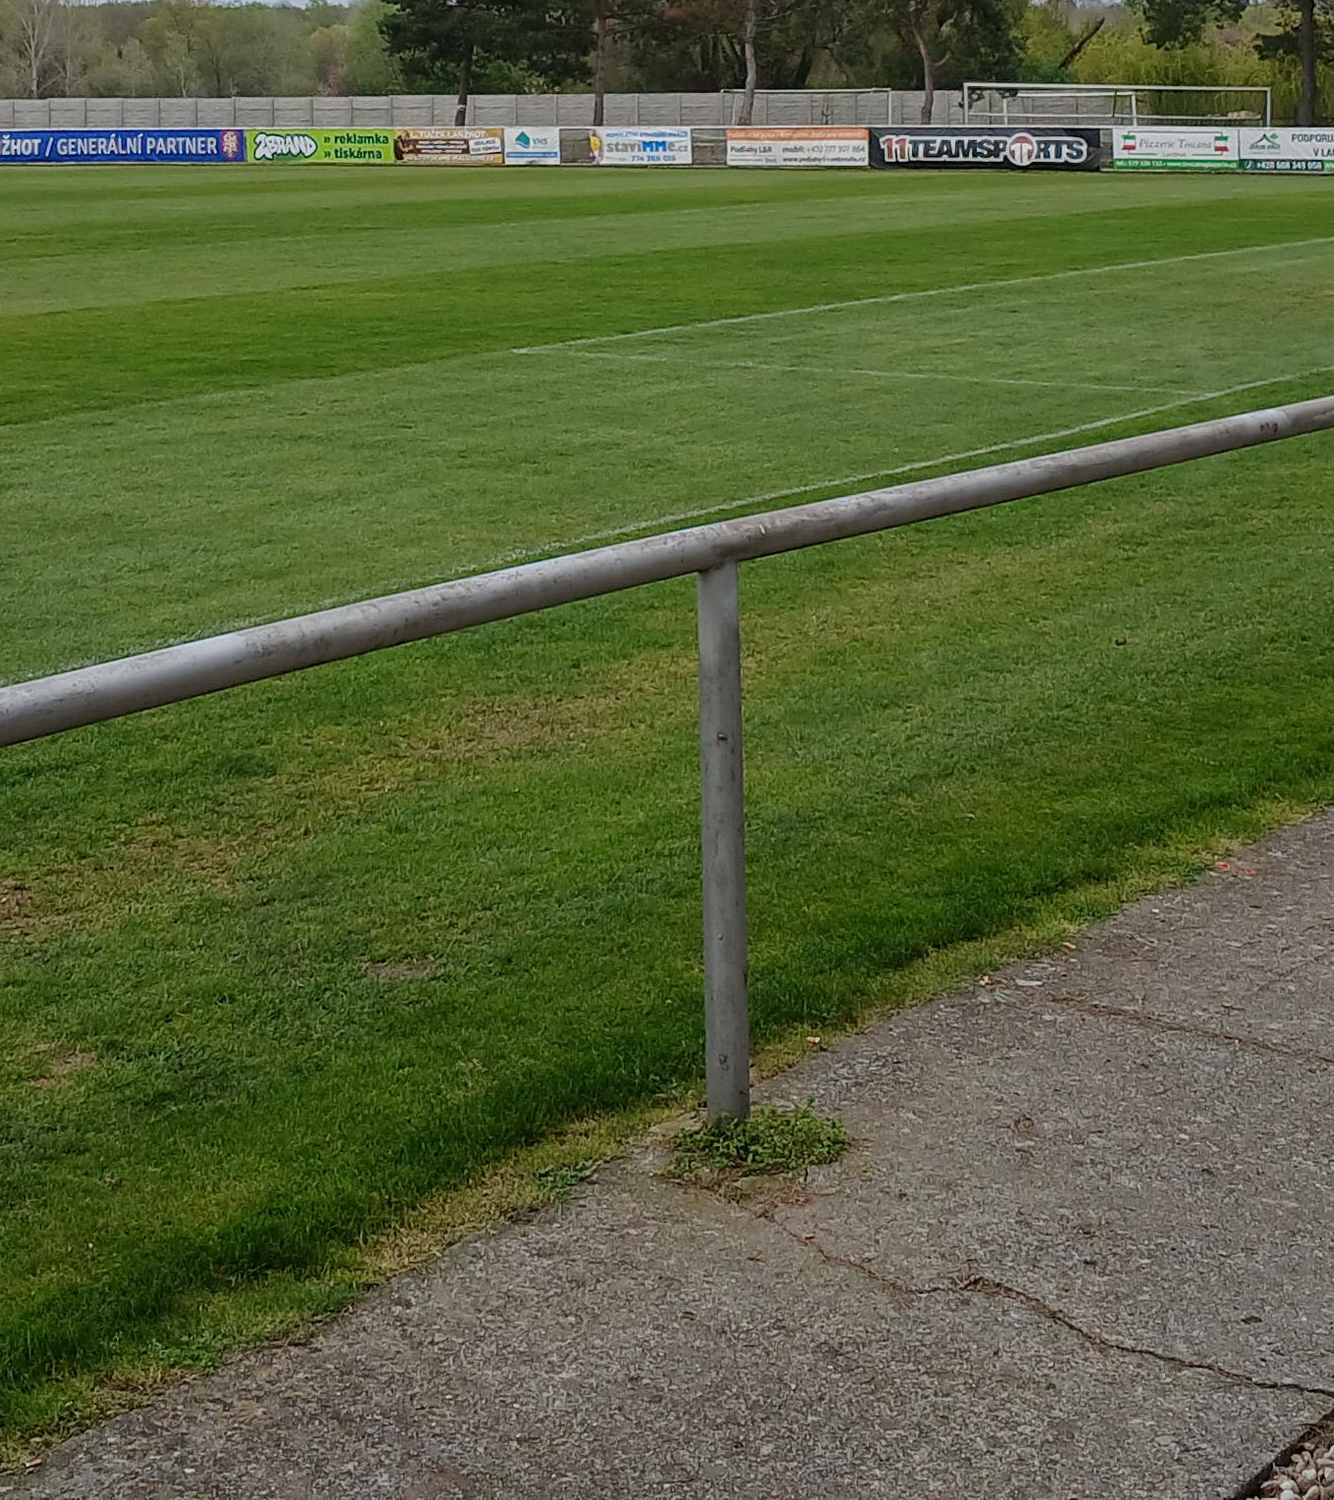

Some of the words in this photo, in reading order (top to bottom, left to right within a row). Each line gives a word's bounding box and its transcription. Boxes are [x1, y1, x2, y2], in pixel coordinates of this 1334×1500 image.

[45, 137, 54, 157] /
[56, 133, 144, 156] GENERÁLNÍ
[146, 135, 218, 155] PARTNER
[334, 147, 383, 160] tiskárna
[1313, 147, 1320, 157] V
